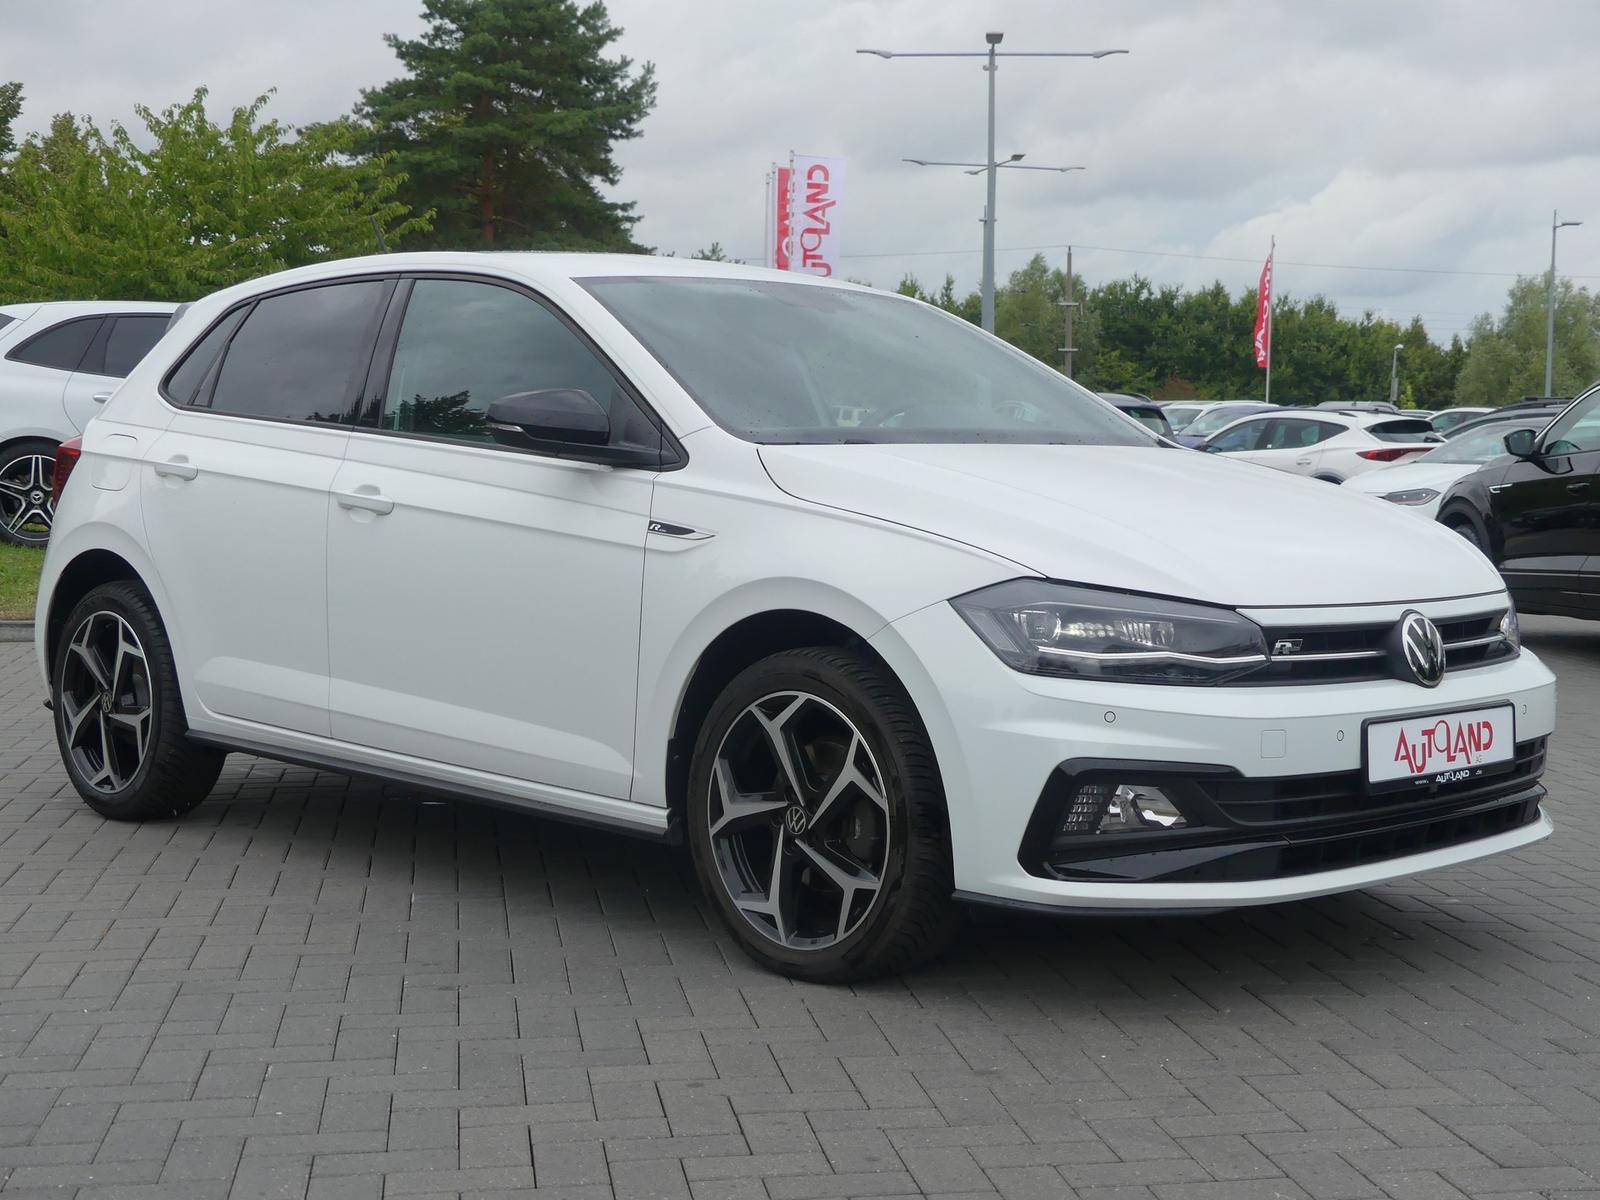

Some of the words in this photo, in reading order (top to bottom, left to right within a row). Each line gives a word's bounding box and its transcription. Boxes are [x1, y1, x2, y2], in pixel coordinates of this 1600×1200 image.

[800, 164, 836, 277] UTOLAND
[1394, 720, 1493, 774] AUTOLAND
[1435, 770, 1470, 783] AUTOLAND
